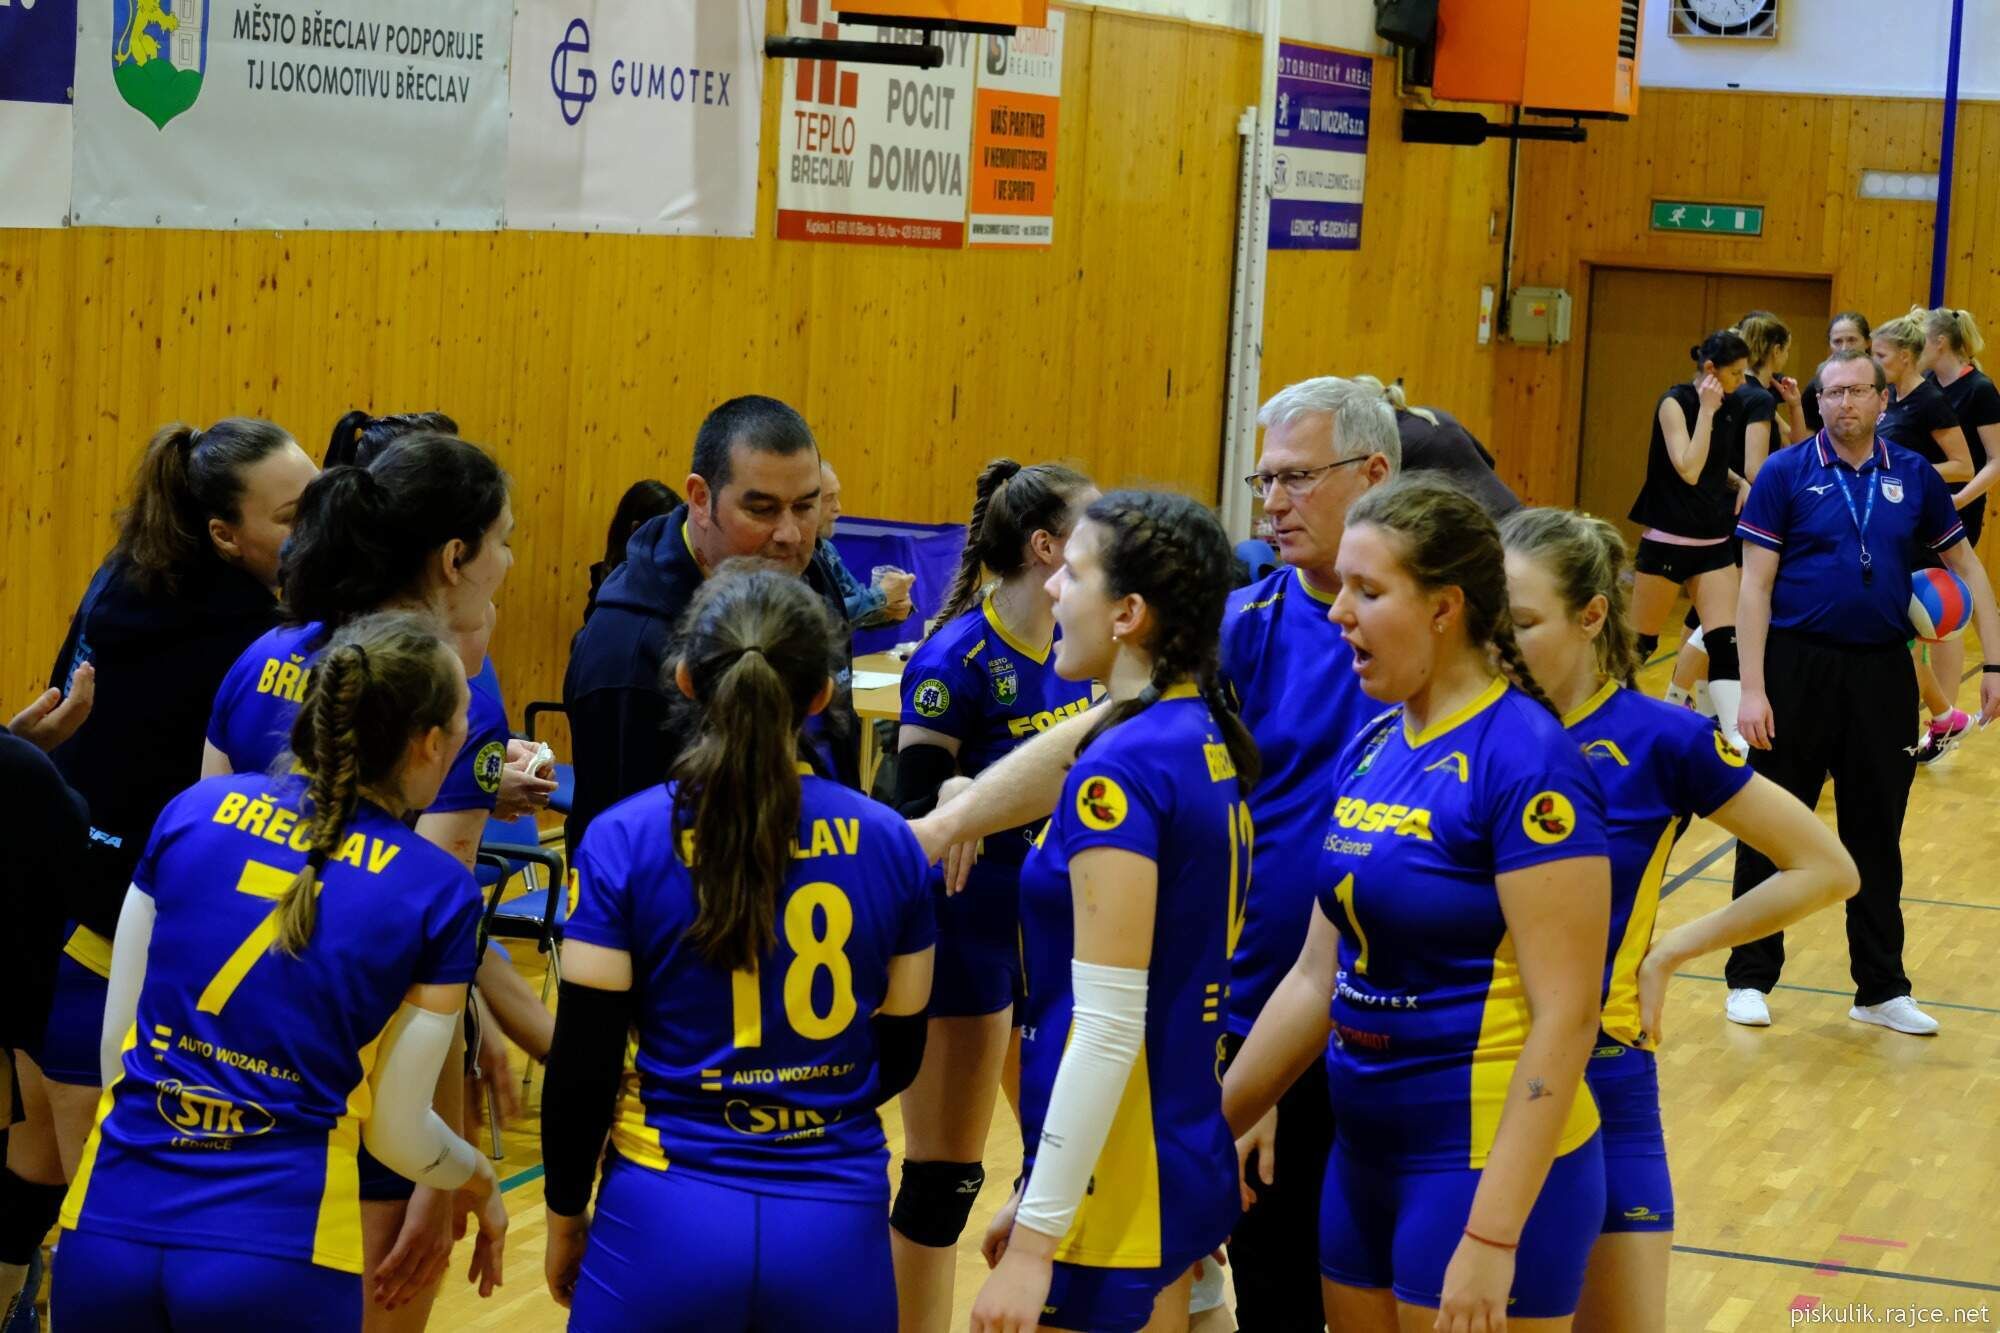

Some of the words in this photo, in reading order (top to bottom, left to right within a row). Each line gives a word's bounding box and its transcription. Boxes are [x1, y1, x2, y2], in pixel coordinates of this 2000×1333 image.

[233, 3, 296, 44] MĚSTO
[301, 9, 381, 51] BŘECLAV
[385, 24, 484, 60] PODPORUJE
[247, 59, 264, 90] TJ
[271, 61, 390, 98] LOKOMOTIVU
[396, 65, 470, 103] BŘECLAV
[611, 59, 731, 106] GUMOTEX
[886, 78, 955, 130] POCIT
[1008, 111, 1045, 138] PARTNER
[1299, 107, 1320, 132] AUTO
[1320, 109, 1349, 134] WOZAR
[794, 111, 856, 155] TEPLO
[868, 143, 962, 196] DOMOVA
[212, 791, 401, 874] BŘECAV
[1333, 796, 1434, 842] FOSFA
[196, 859, 323, 1016] 7
[178, 1035, 213, 1058] AUTO
[215, 1046, 269, 1075] WOZAR
[732, 1069, 774, 1085] AUTO
[777, 1065, 829, 1082] WOZAR
[175, 1091, 245, 1133] STK
